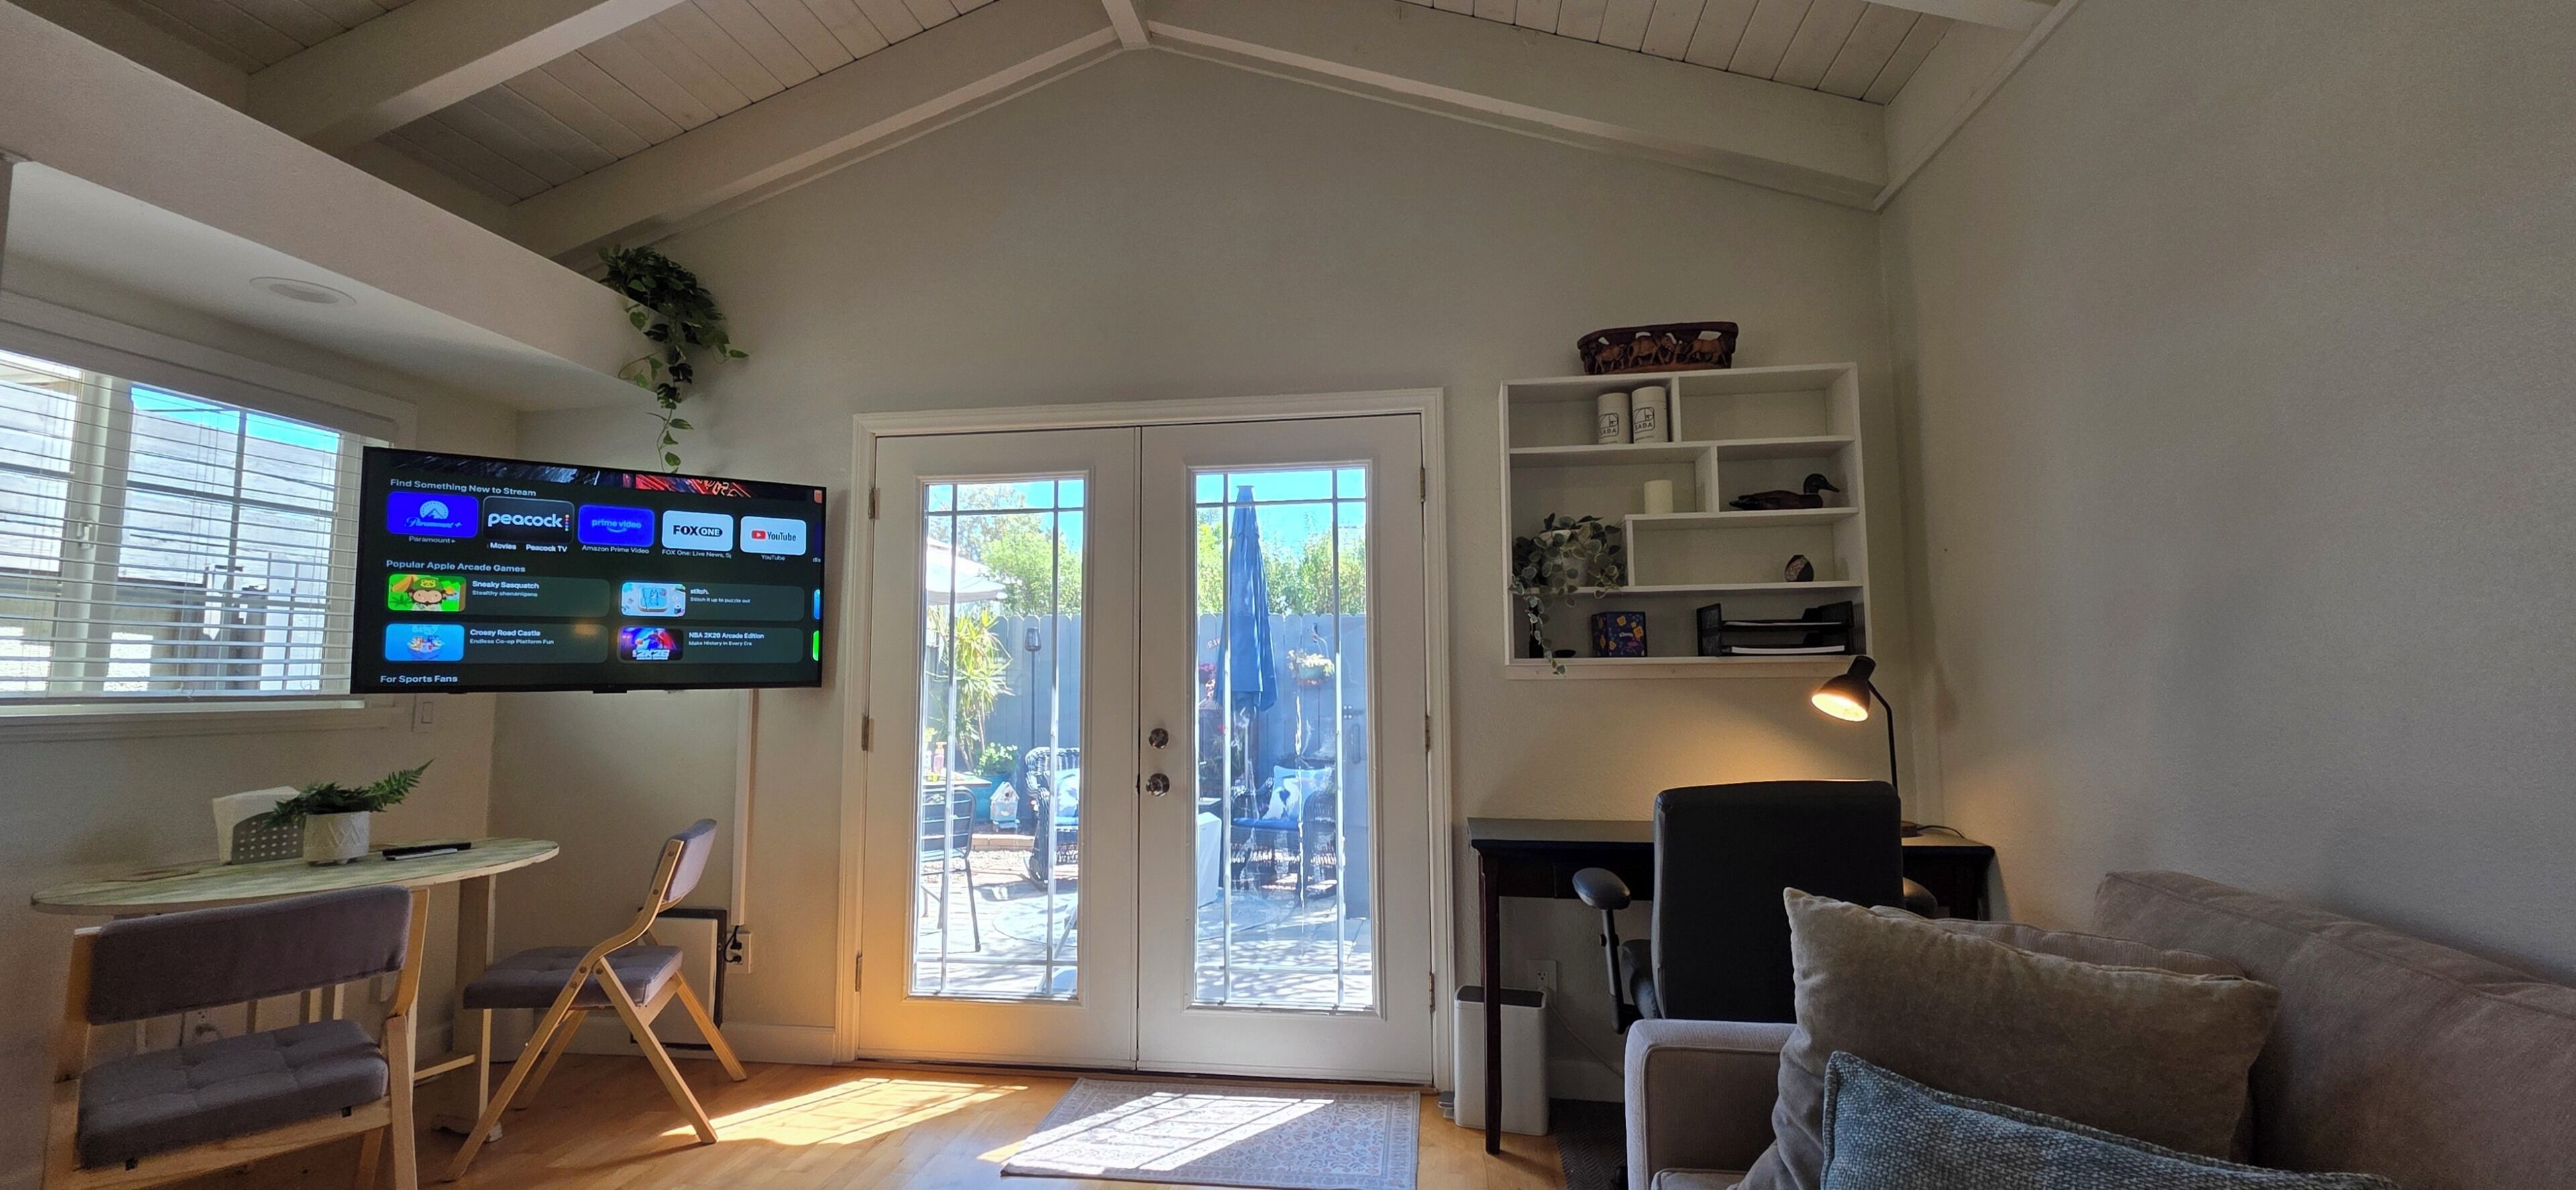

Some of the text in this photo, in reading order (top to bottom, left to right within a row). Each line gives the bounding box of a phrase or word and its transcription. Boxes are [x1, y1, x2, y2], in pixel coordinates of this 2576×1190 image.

[390, 478, 537, 496] Find Something New to Stream
[404, 516, 462, 529] Paramount+
[488, 512, 564, 529] peacock
[591, 519, 642, 529] prime video
[673, 525, 720, 536] FOX ONE
[409, 536, 456, 544] Paramount+
[767, 531, 796, 542] YouTube
[490, 542, 517, 550] Movies
[525, 544, 556, 552] Peacock
[386, 559, 526, 573] Popular Apple Arcade Games
[472, 580, 539, 590] Sneaky Sasquatch
[398, 675, 433, 685] Sports
